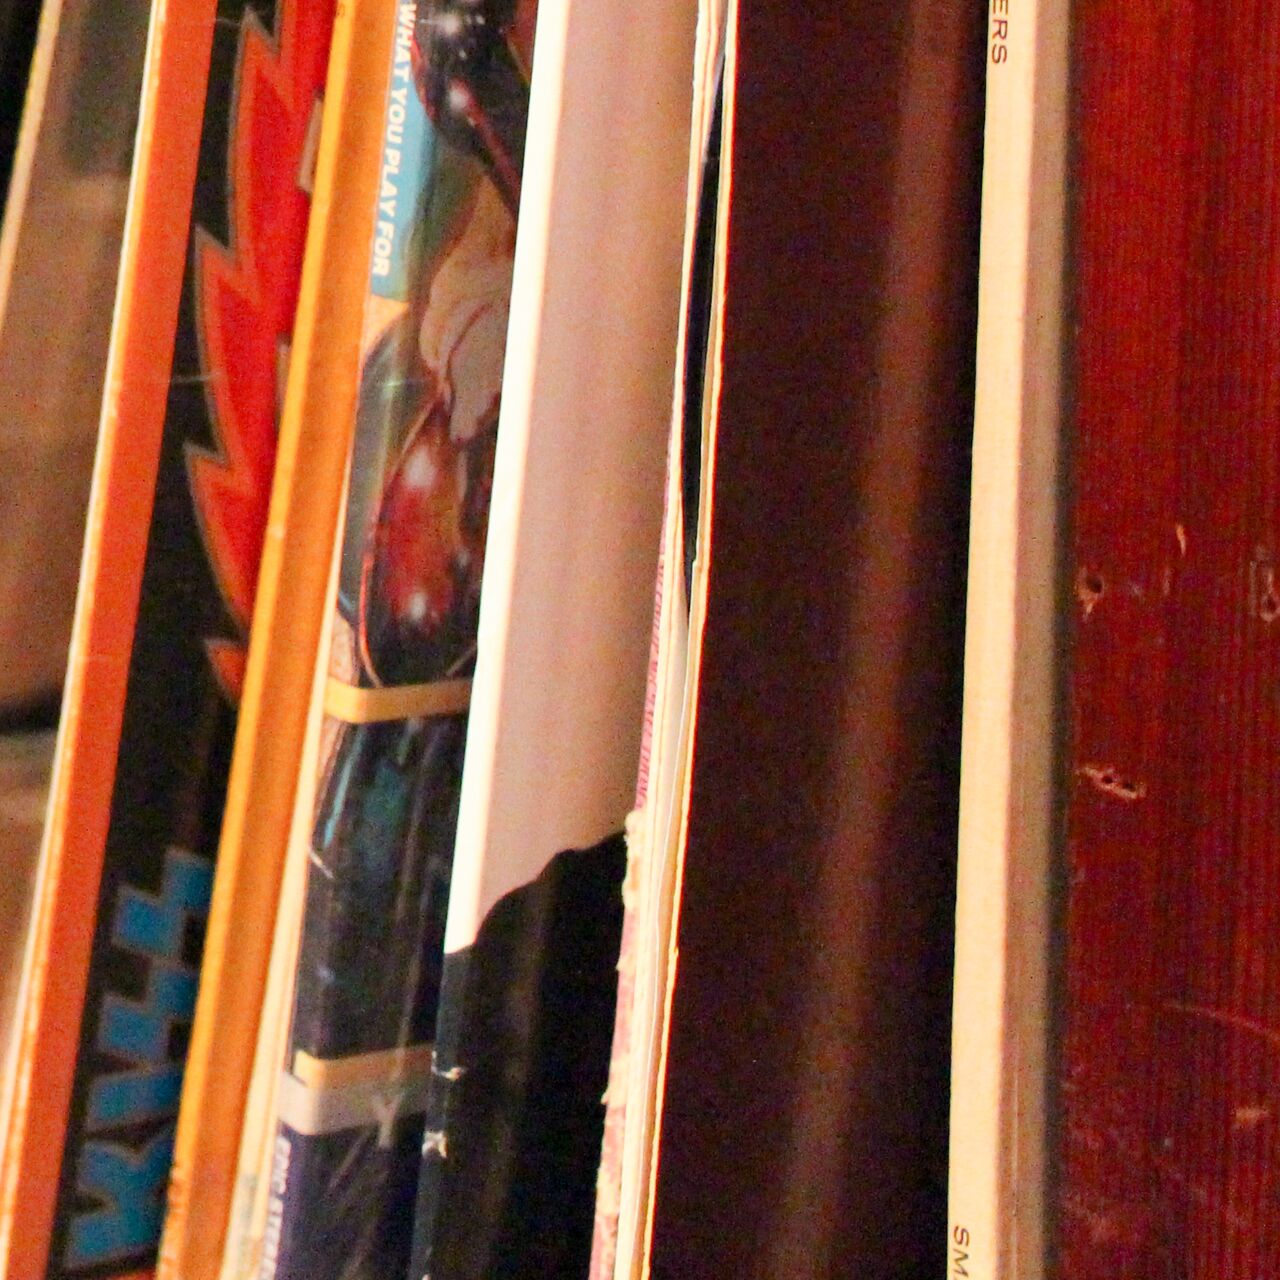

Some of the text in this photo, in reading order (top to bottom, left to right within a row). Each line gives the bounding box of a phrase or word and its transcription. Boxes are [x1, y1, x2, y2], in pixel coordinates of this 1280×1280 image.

[393, 4, 417, 82] WHAT
[387, 87, 408, 144] YOU
[379, 148, 401, 217] PLAY
[372, 221, 395, 277] FOR
[953, 1225, 970, 1280] SM
